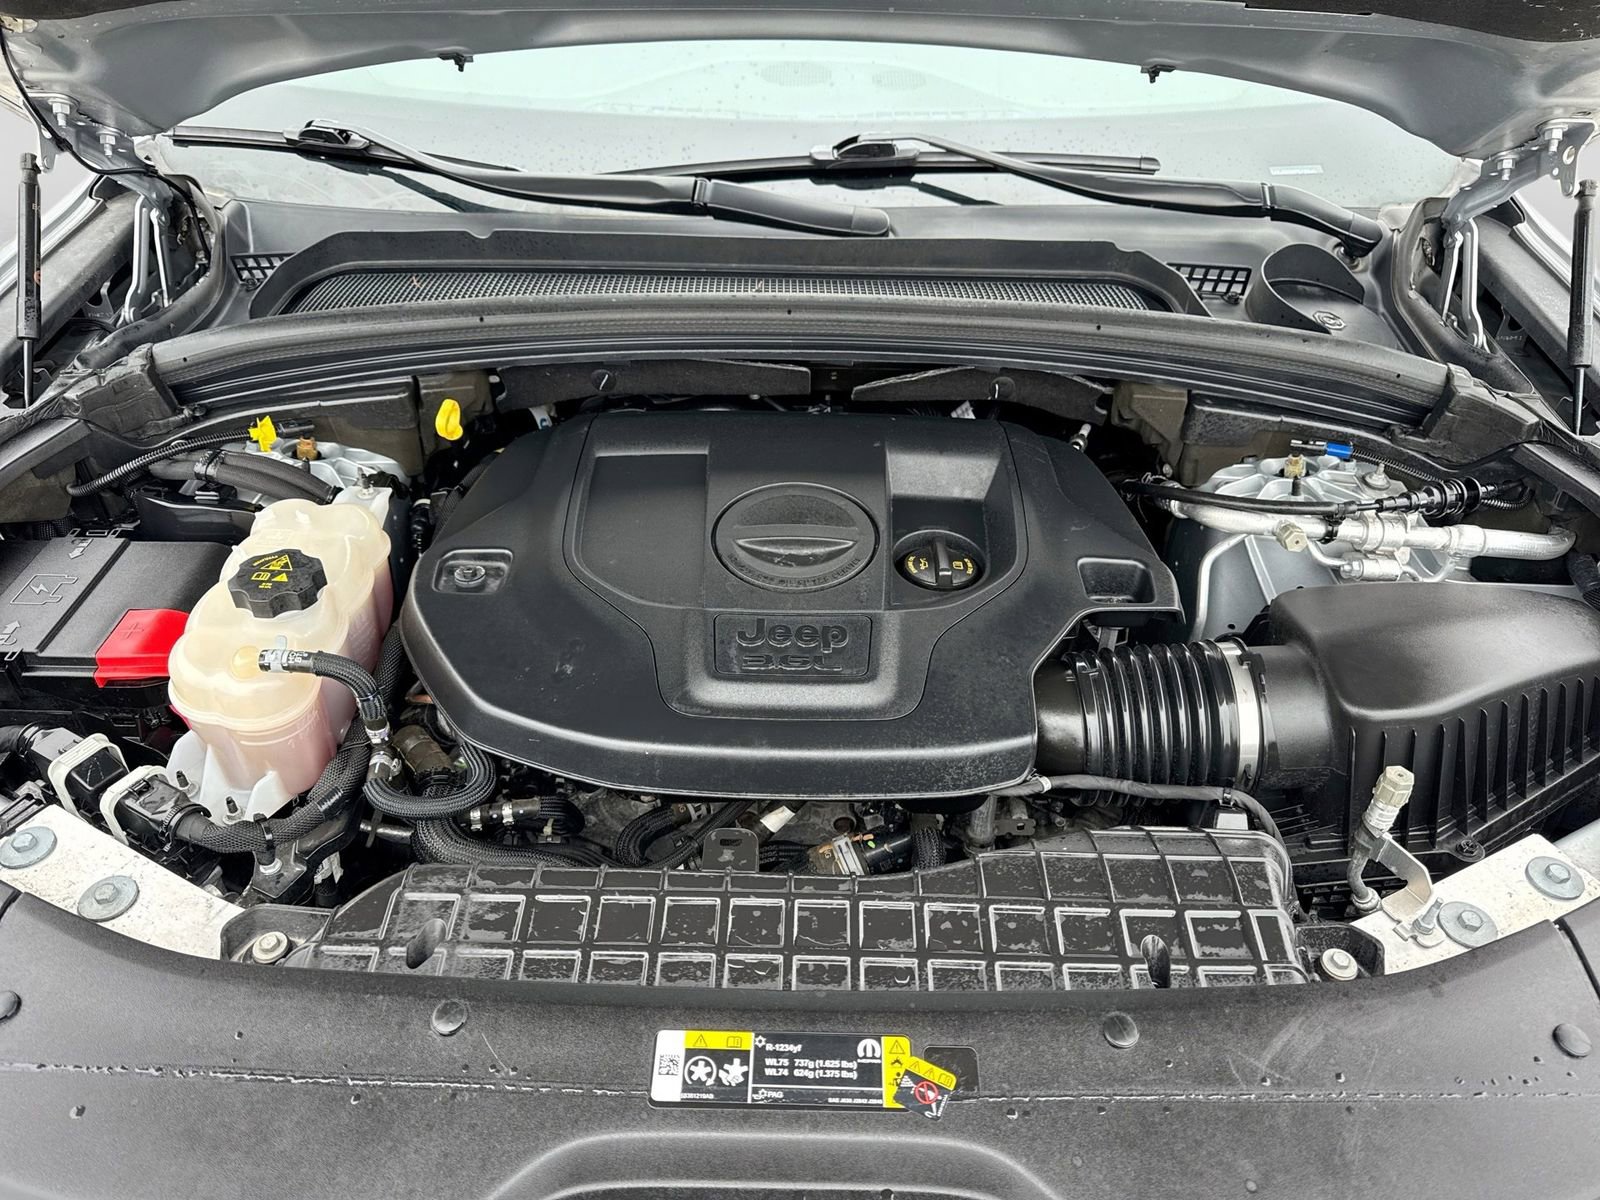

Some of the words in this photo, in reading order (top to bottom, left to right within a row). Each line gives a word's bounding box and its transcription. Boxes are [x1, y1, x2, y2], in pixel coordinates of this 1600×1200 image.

[736, 618, 849, 653] Jeep
[741, 654, 843, 671] 3.6L
[765, 1043, 802, 1053] R-1234yf
[764, 1058, 789, 1067] WL75
[793, 1058, 815, 1069] 737g
[815, 1059, 840, 1069] (1.625
[841, 1060, 858, 1070] lbs)
[764, 1068, 789, 1076] WL74
[793, 1069, 815, 1079] 624g
[815, 1070, 840, 1079] (1.375
[841, 1070, 858, 1080] lbs)
[767, 1091, 784, 1099] PAG
